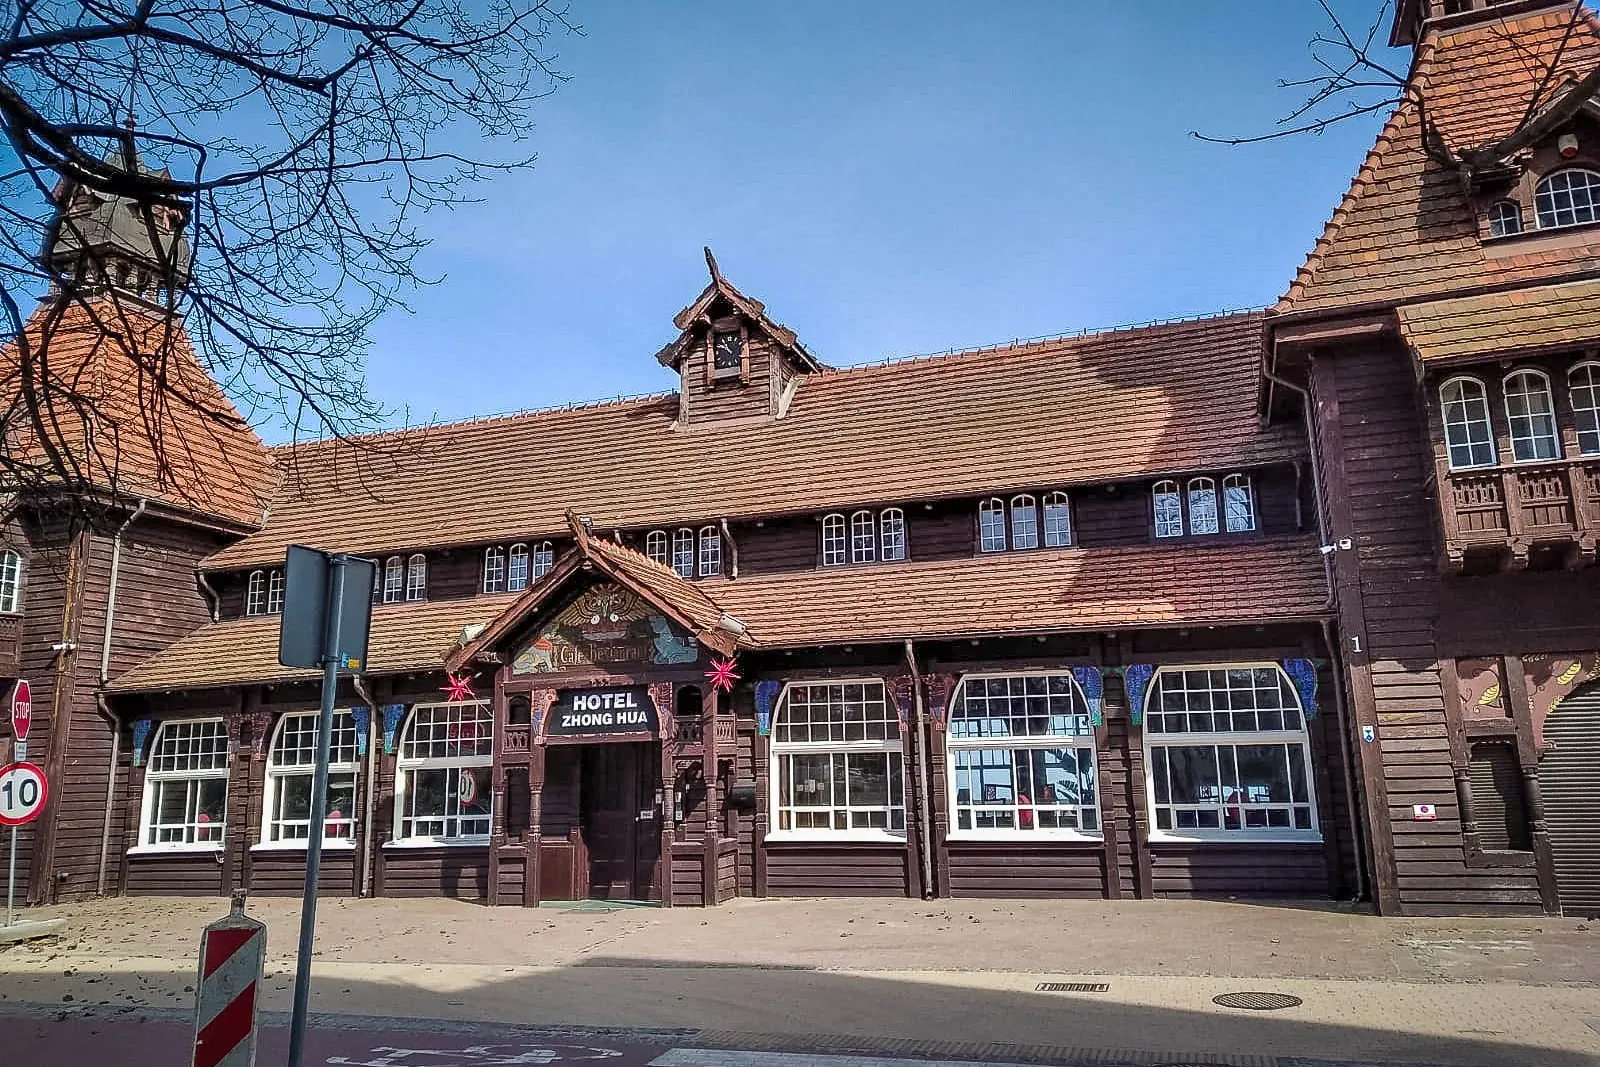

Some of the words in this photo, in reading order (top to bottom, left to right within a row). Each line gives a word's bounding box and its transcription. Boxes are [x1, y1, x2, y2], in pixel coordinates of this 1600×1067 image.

[1351, 636, 1363, 653] 1
[573, 692, 638, 711] HOTEL
[15, 702, 30, 719] STOP
[561, 713, 613, 728] ZHONG
[616, 711, 648, 725] HUA
[2, 778, 38, 810] 10
